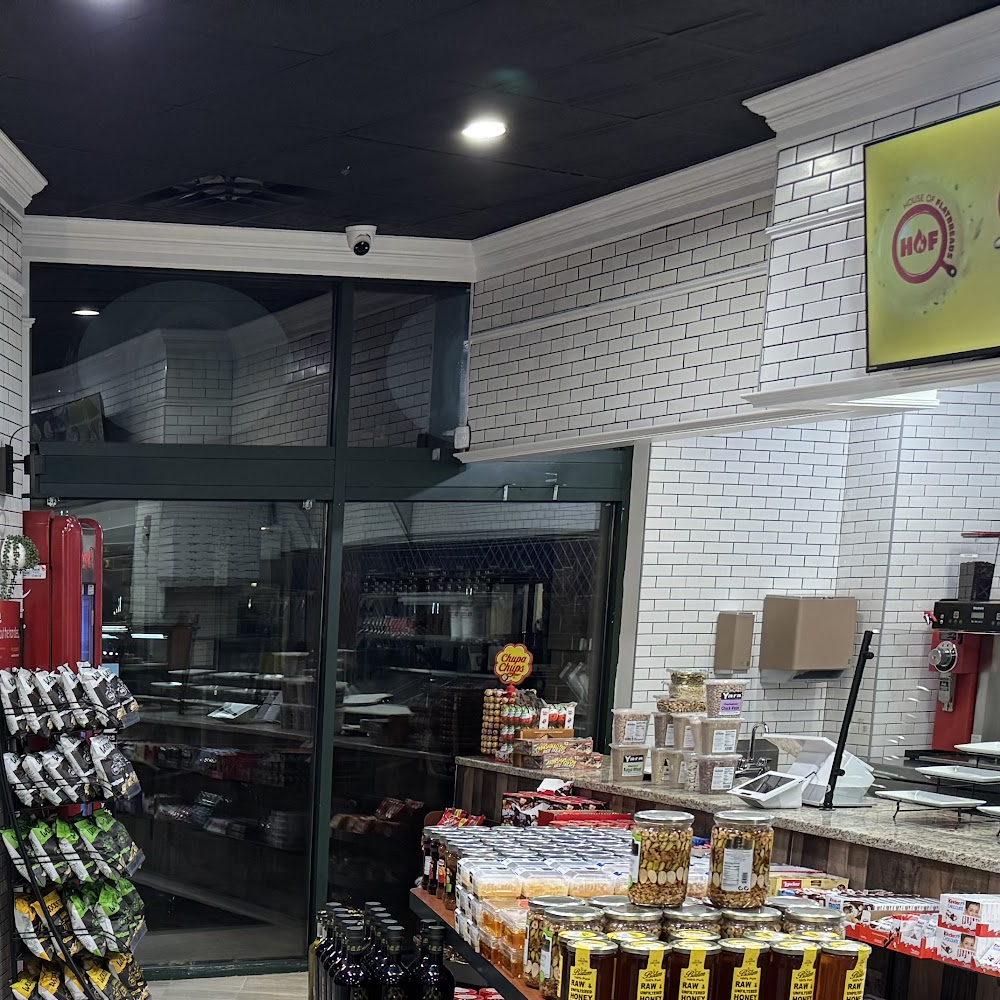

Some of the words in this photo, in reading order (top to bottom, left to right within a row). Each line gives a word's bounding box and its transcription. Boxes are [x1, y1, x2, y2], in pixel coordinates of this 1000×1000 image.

[903, 194, 924, 210] HOUSE
[926, 194, 935, 203] OF
[501, 653, 527, 664] Chupa
[498, 663, 524, 673] Chups
[571, 979, 585, 988] RAW
[640, 982, 657, 990] RAW
[570, 993, 593, 1000] HONEY
